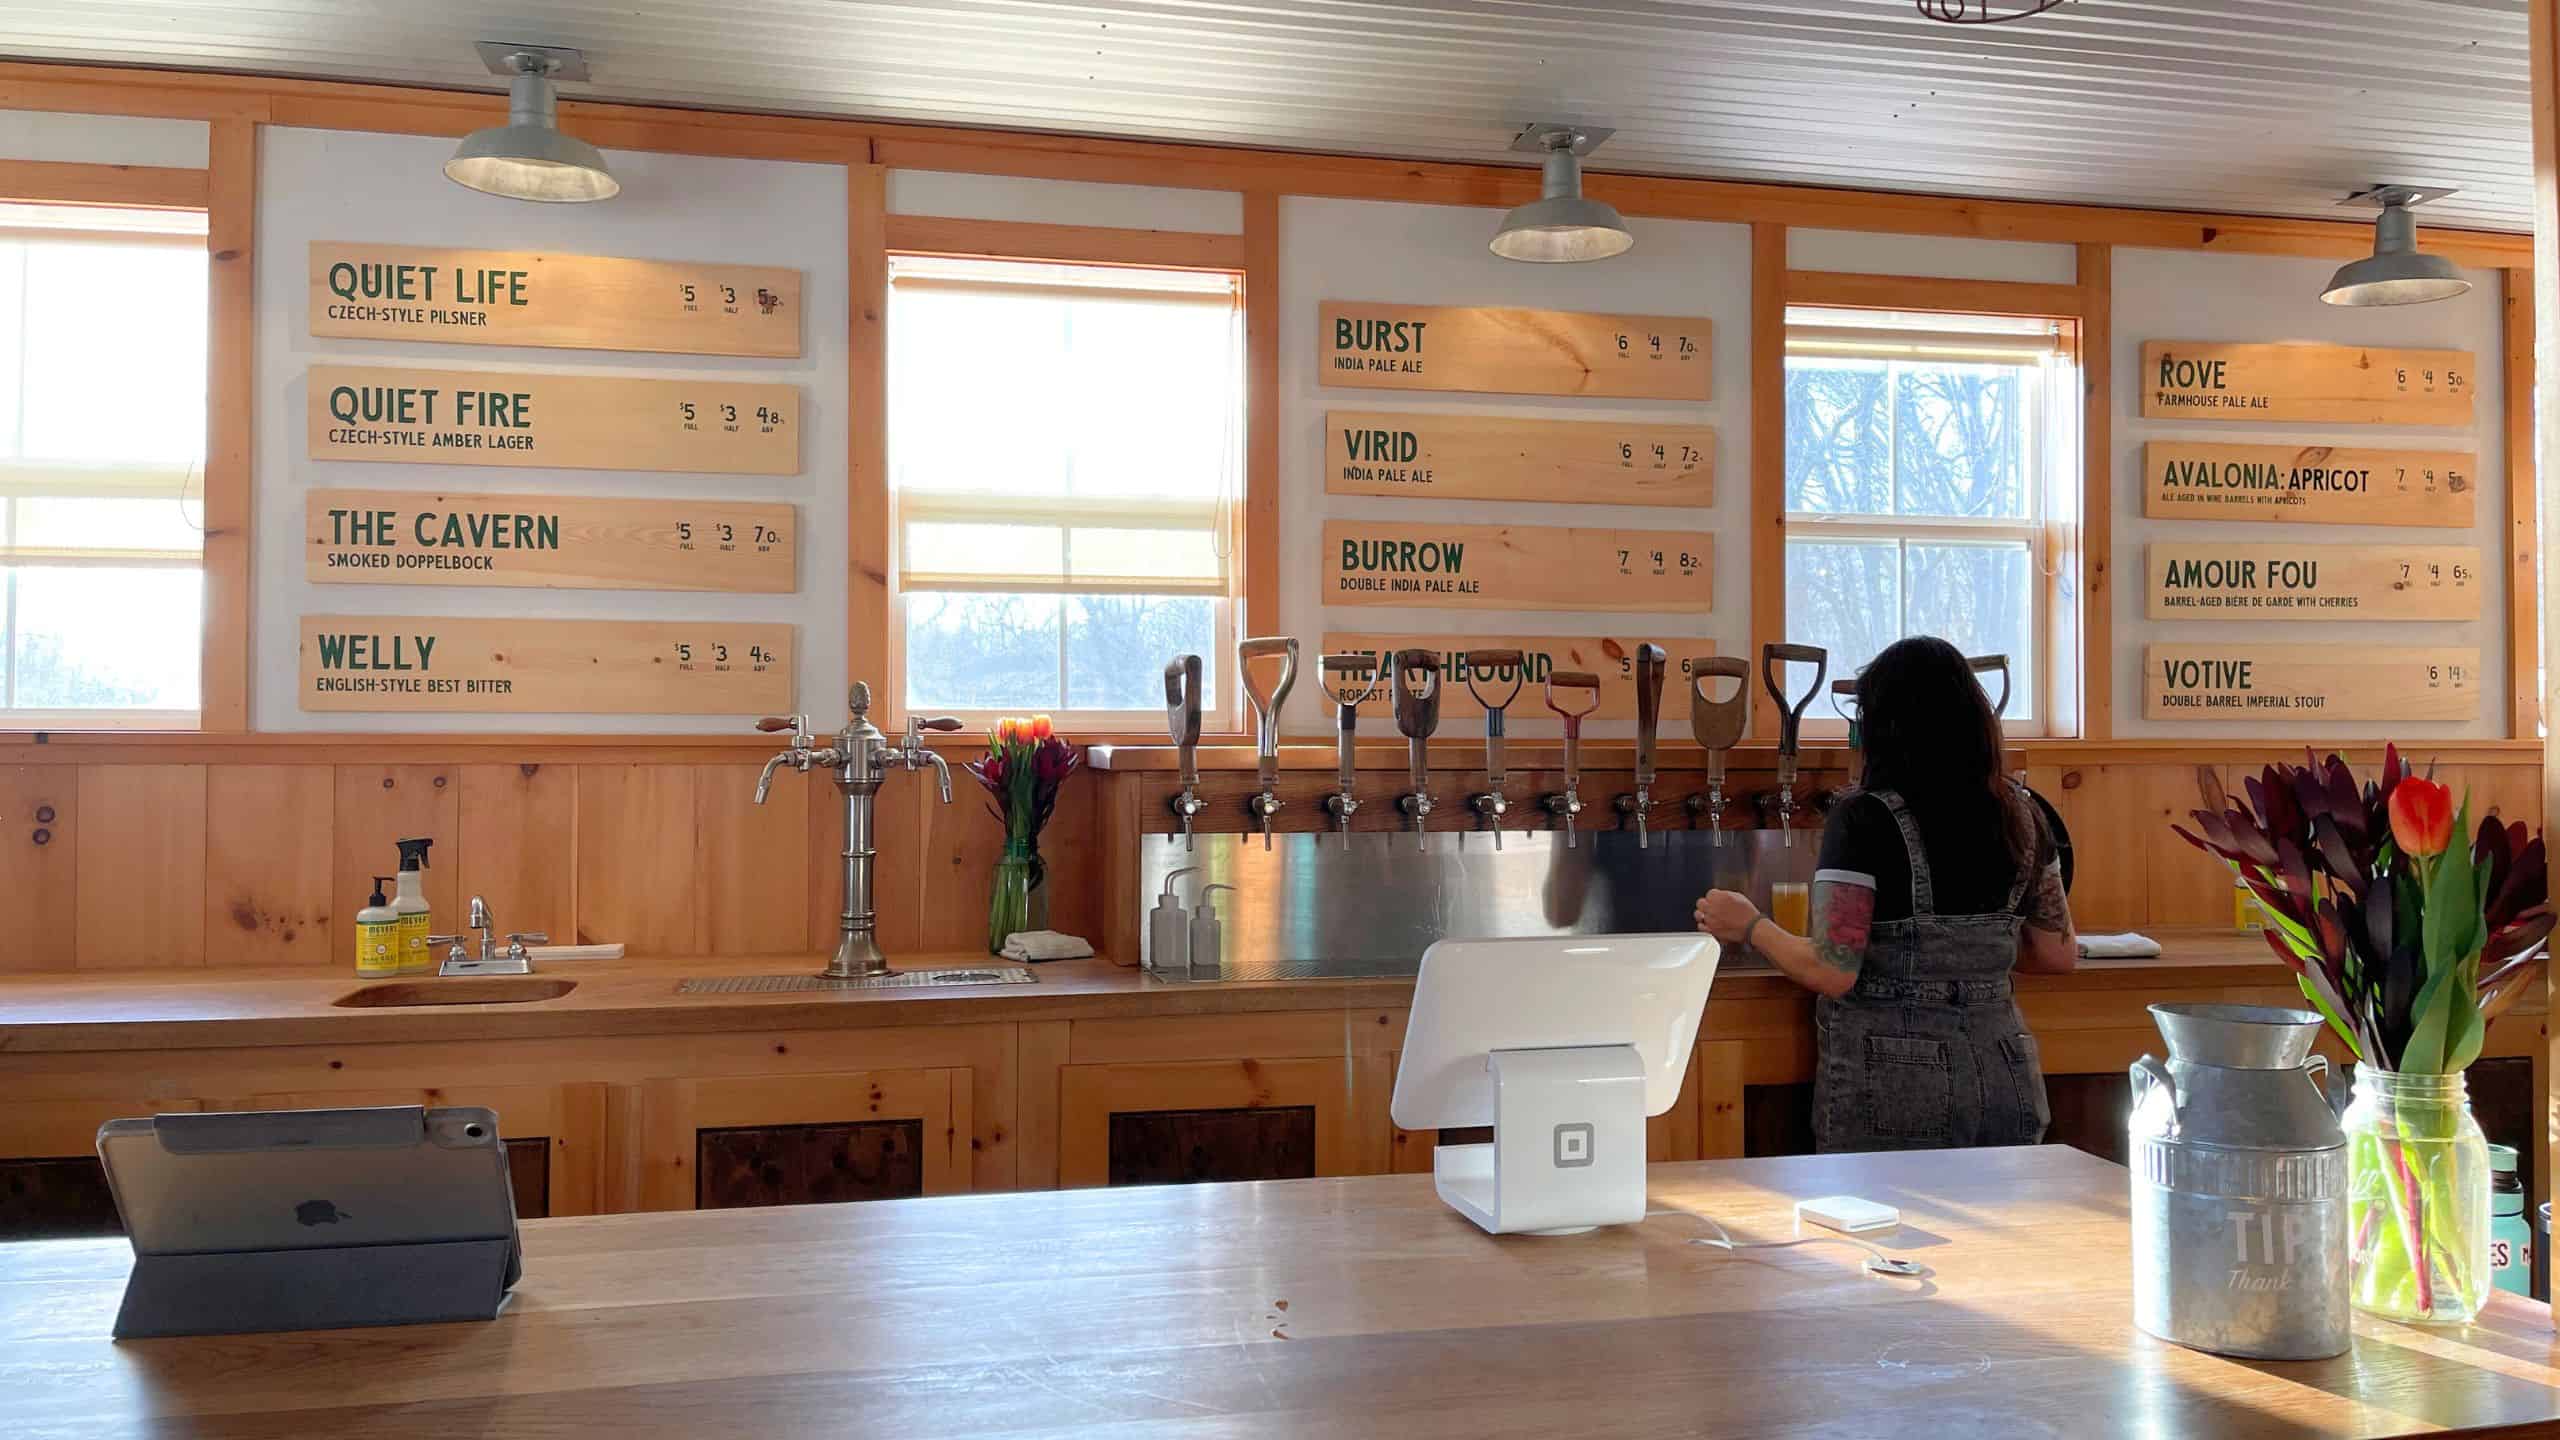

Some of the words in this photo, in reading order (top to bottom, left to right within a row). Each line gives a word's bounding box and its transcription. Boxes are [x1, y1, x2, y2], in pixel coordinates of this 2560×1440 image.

[329, 262, 437, 302] QUIET
[456, 268, 528, 305] LIFE
[328, 305, 424, 323] CZECH-STYLE
[430, 309, 486, 327] PILSNER
[1336, 318, 1426, 353] BURST
[1334, 357, 1364, 371] INDIA
[1369, 359, 1397, 373] PALE
[1402, 360, 1423, 374] ALE
[2160, 360, 2226, 389] ROVE
[330, 386, 438, 425] QUIET
[456, 391, 530, 427] FIRE
[2158, 394, 2217, 407] FARMHOUSE
[2222, 395, 2247, 408] PALE
[2250, 396, 2269, 409] ALE
[329, 429, 425, 446] CZECH-STYLE
[432, 432, 482, 448] AMBER
[488, 433, 534, 450] LAGER
[1345, 429, 1417, 462] VIRID
[1343, 467, 1373, 481] INDIA
[1378, 468, 1407, 482] PALE
[1412, 470, 1433, 483] ALE
[2164, 461, 2285, 490] AVALONIA:
[2289, 468, 2369, 492] APRICOT
[2274, 496, 2306, 505] APRICOTS
[328, 510, 396, 545] THE
[414, 513, 559, 550] CAVERN
[328, 554, 390, 568] SMOKED
[396, 555, 493, 570] DOPPELBOCK
[1341, 540, 1464, 574] BURROW
[1340, 579, 1386, 592] DOUBLE
[1391, 579, 1421, 592] INDIA
[1425, 580, 1454, 593] PALE
[1458, 581, 1479, 594] ALE
[2165, 559, 2256, 589] AMOUR
[2268, 560, 2317, 589] FOU
[2164, 597, 2222, 606] BARREL-AGED
[2252, 597, 2263, 607] DE
[2266, 597, 2293, 607] GARDE
[2297, 597, 2316, 607] WITH
[2319, 597, 2358, 608] CHERRIES
[318, 635, 435, 670] WELLY
[1341, 651, 1552, 682] HEAHBOUND
[317, 678, 420, 692] ENGLISH-STYLE
[428, 680, 460, 693] BEST
[467, 680, 512, 694] BITTER
[2163, 660, 2252, 689] VOTIVE
[2163, 695, 2201, 707] DOUBLE
[2206, 695, 2242, 708] BARREL
[2247, 696, 2290, 708] IMPERIAL
[2294, 697, 2325, 708] STOUT
